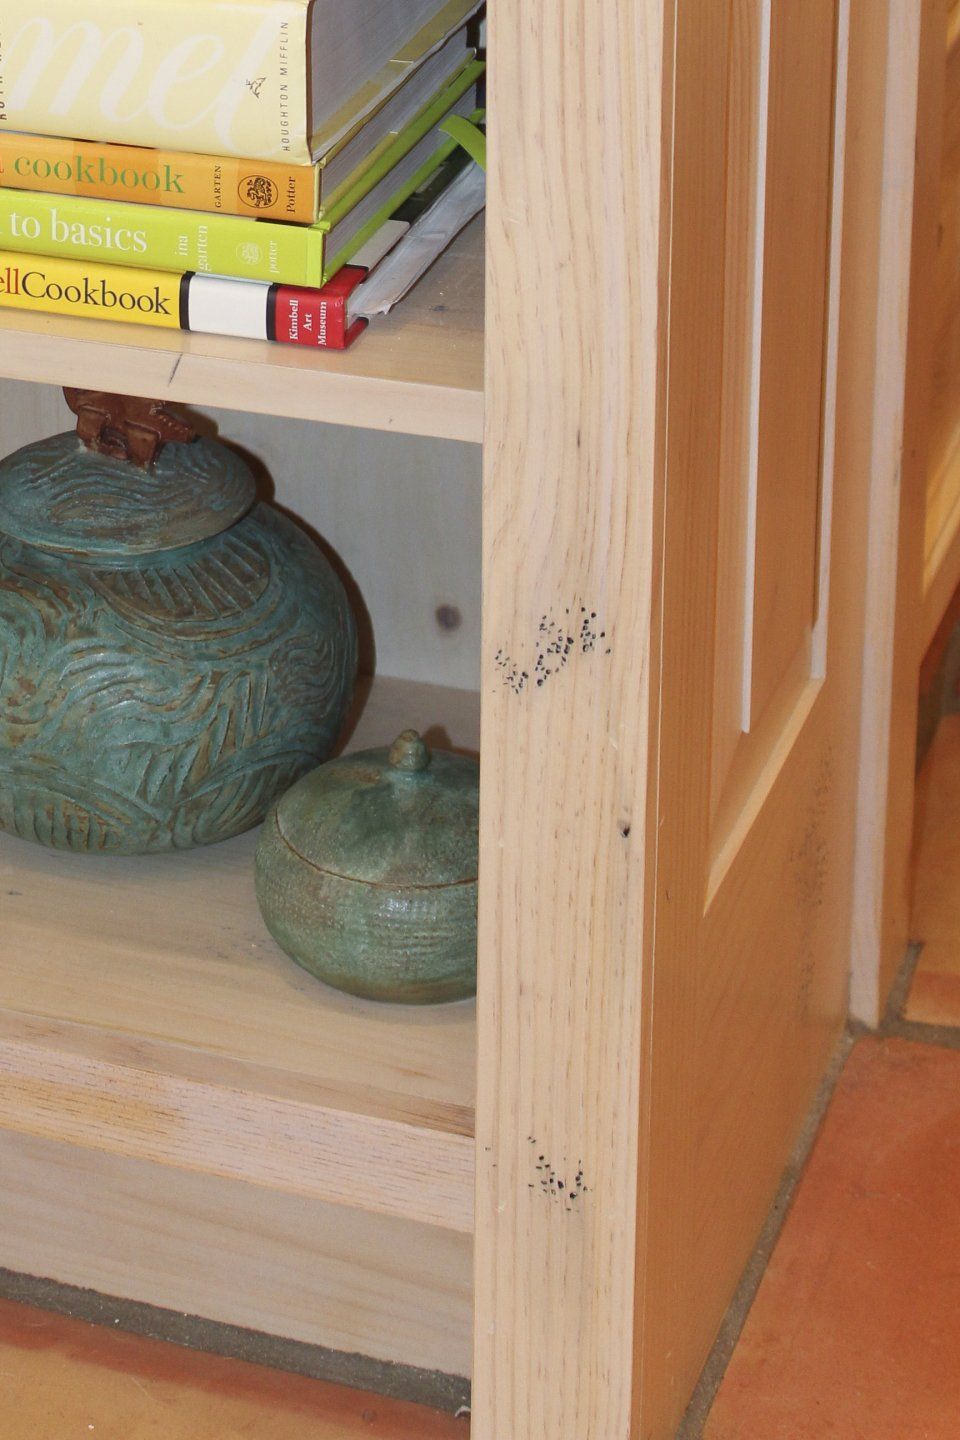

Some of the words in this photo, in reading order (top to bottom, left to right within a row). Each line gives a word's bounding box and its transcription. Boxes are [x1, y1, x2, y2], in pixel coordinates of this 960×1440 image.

[279, 21, 289, 76] MIFFLIN
[279, 84, 290, 152] HOUGHTON
[14, 154, 186, 194] cookbook
[214, 164, 222, 209] GARTEN
[286, 176, 296, 213] Potter
[11, 211, 41, 238] to
[50, 208, 147, 253] basics
[174, 235, 188, 256] ina
[197, 224, 209, 273] garten
[268, 240, 278, 274] potter
[289, 298, 299, 340] Kimbell
[302, 312, 312, 331] Art
[317, 301, 328, 346] Museum
